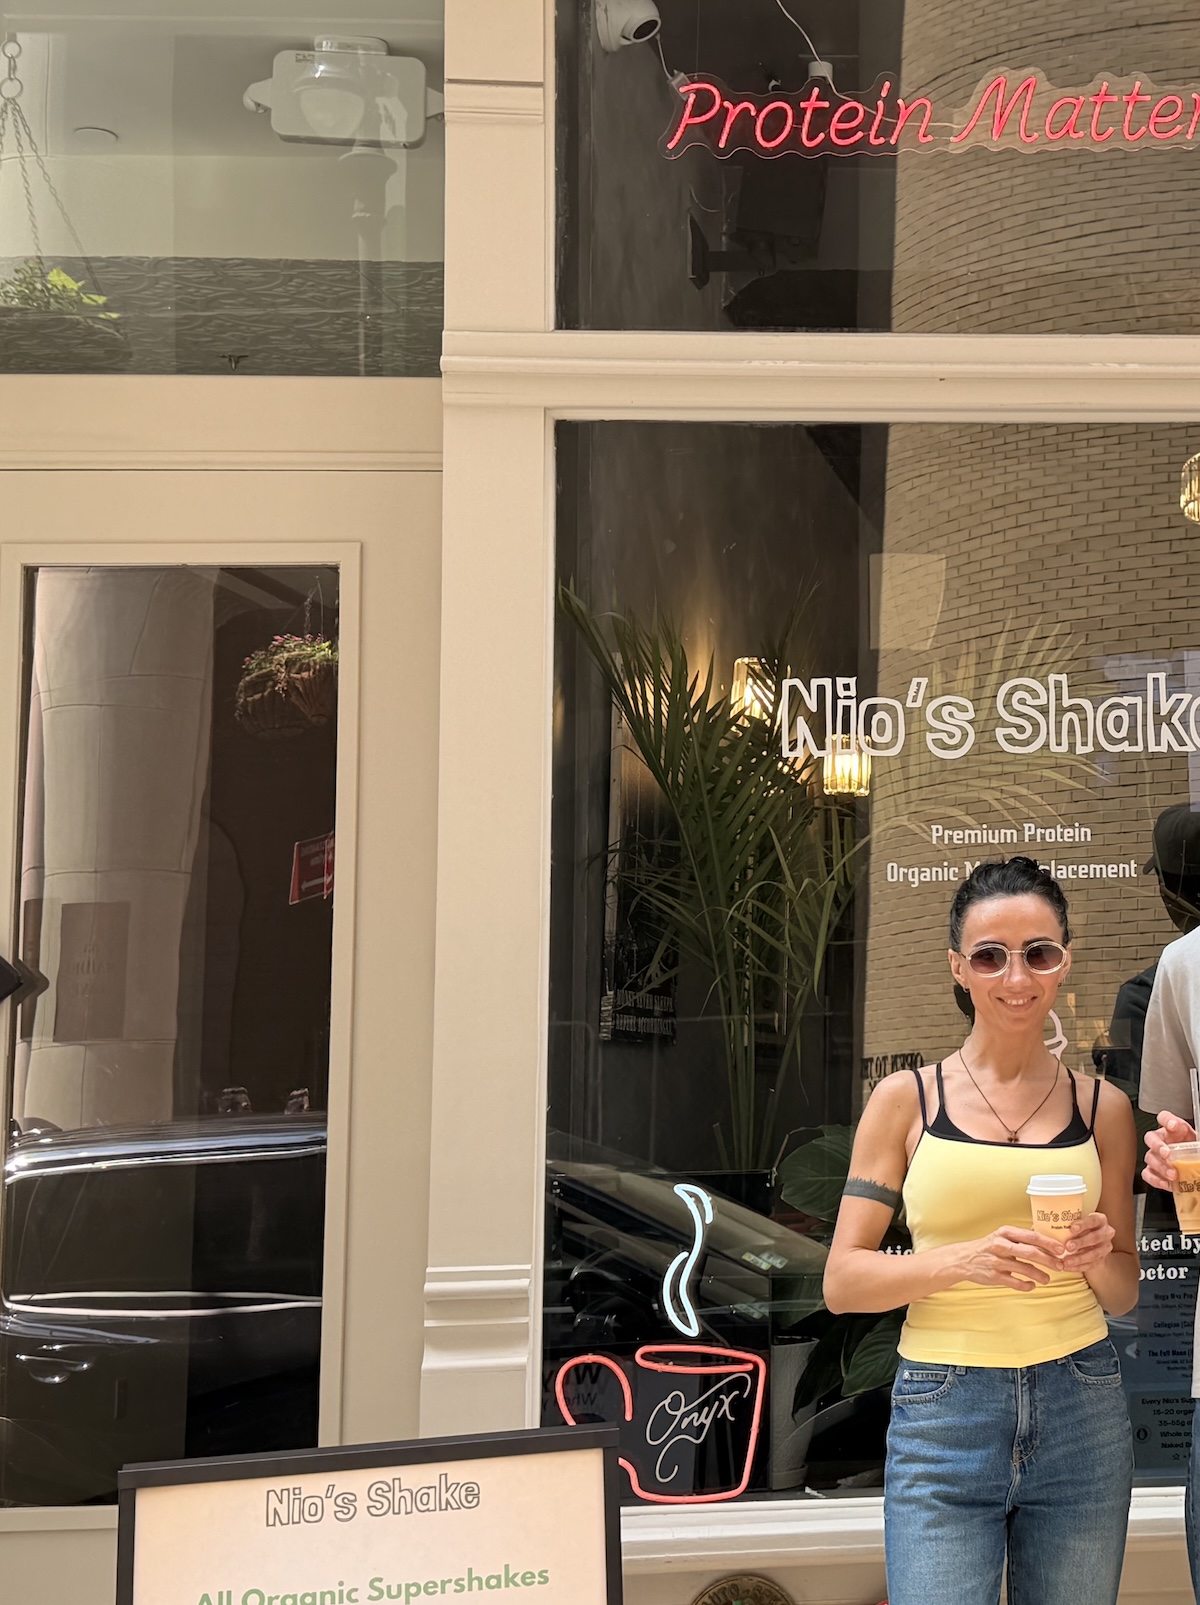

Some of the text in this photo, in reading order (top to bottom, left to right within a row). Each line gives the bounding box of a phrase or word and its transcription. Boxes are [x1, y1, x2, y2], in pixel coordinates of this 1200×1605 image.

[667, 81, 932, 150] Protein
[781, 676, 976, 760] Nio's
[930, 822, 1092, 845] Premium Protein
[886, 862, 959, 888] Organic
[1036, 1209, 1060, 1223] Nio's
[646, 1372, 752, 1483] Onyx
[265, 1472, 481, 1528] Nio's Shake
[197, 1563, 551, 1605] All Organic Supershakes
